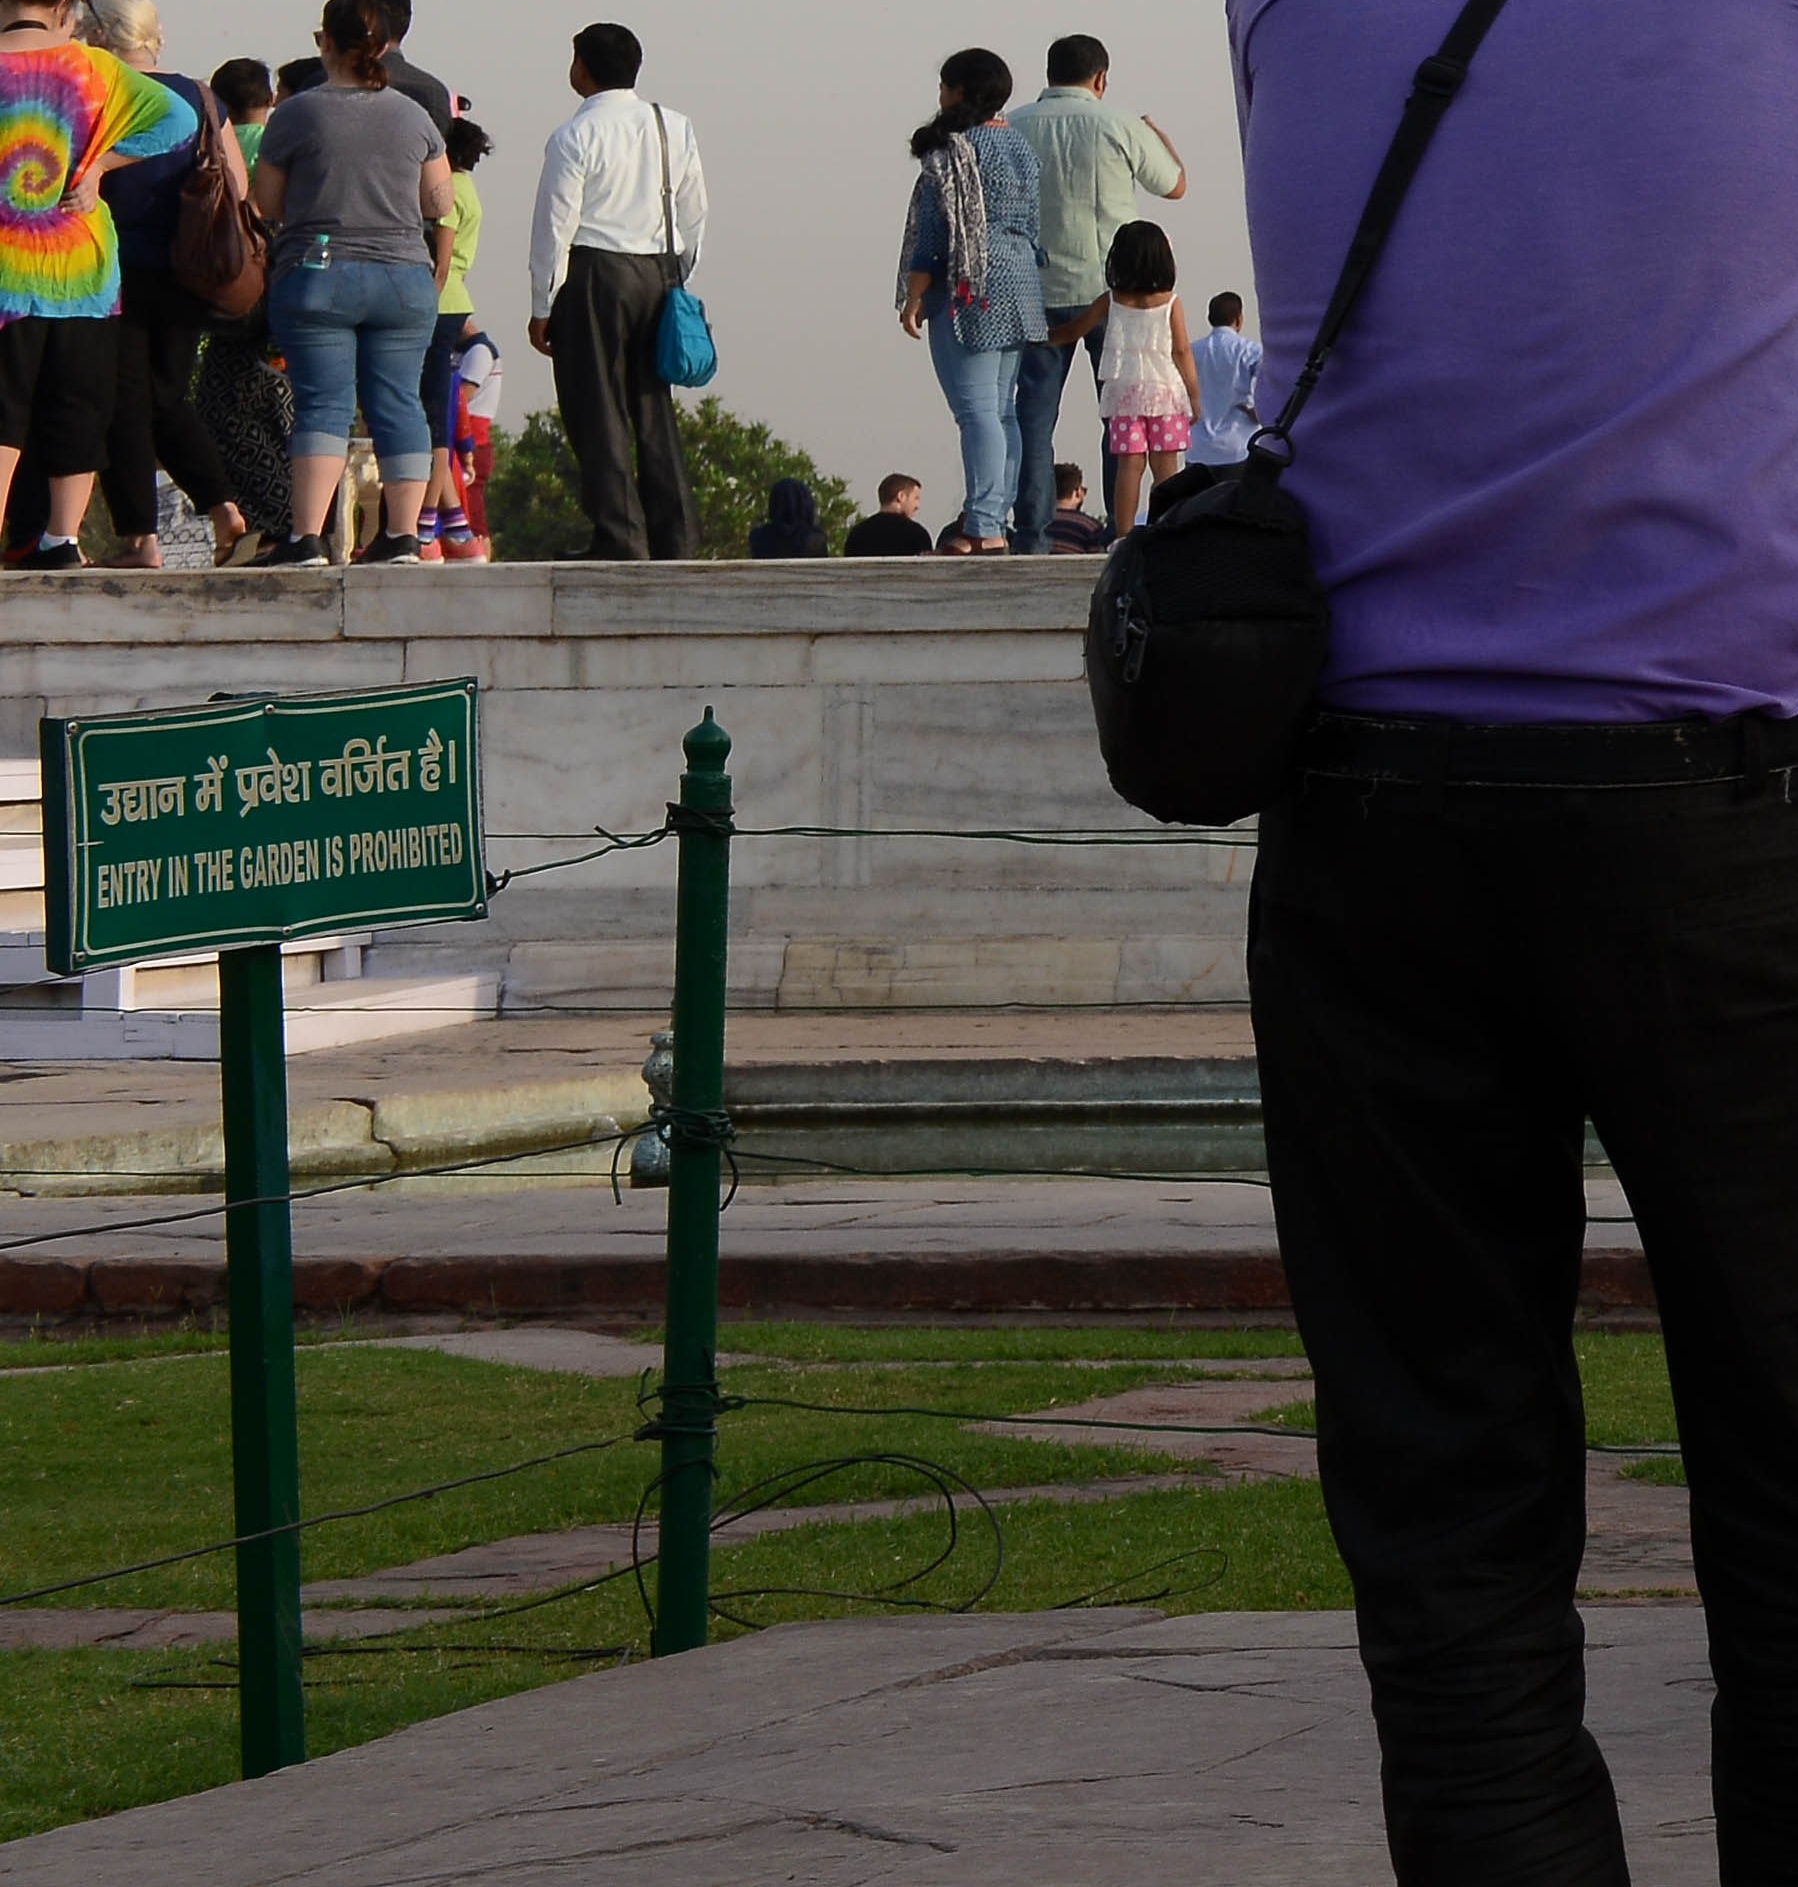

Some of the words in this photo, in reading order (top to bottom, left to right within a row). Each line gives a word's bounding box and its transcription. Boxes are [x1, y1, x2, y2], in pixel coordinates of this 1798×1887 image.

[98, 776, 186, 825] उद्यान
[194, 755, 228, 812] में
[235, 747, 312, 818] प्रवेश
[319, 735, 411, 798] वर्जित
[98, 858, 162, 909] ENTRY
[168, 855, 189, 898] IN
[194, 849, 234, 894] THE
[240, 839, 319, 889] GARDEN
[325, 835, 344, 878] IS
[350, 823, 463, 875] PROHIBITED
